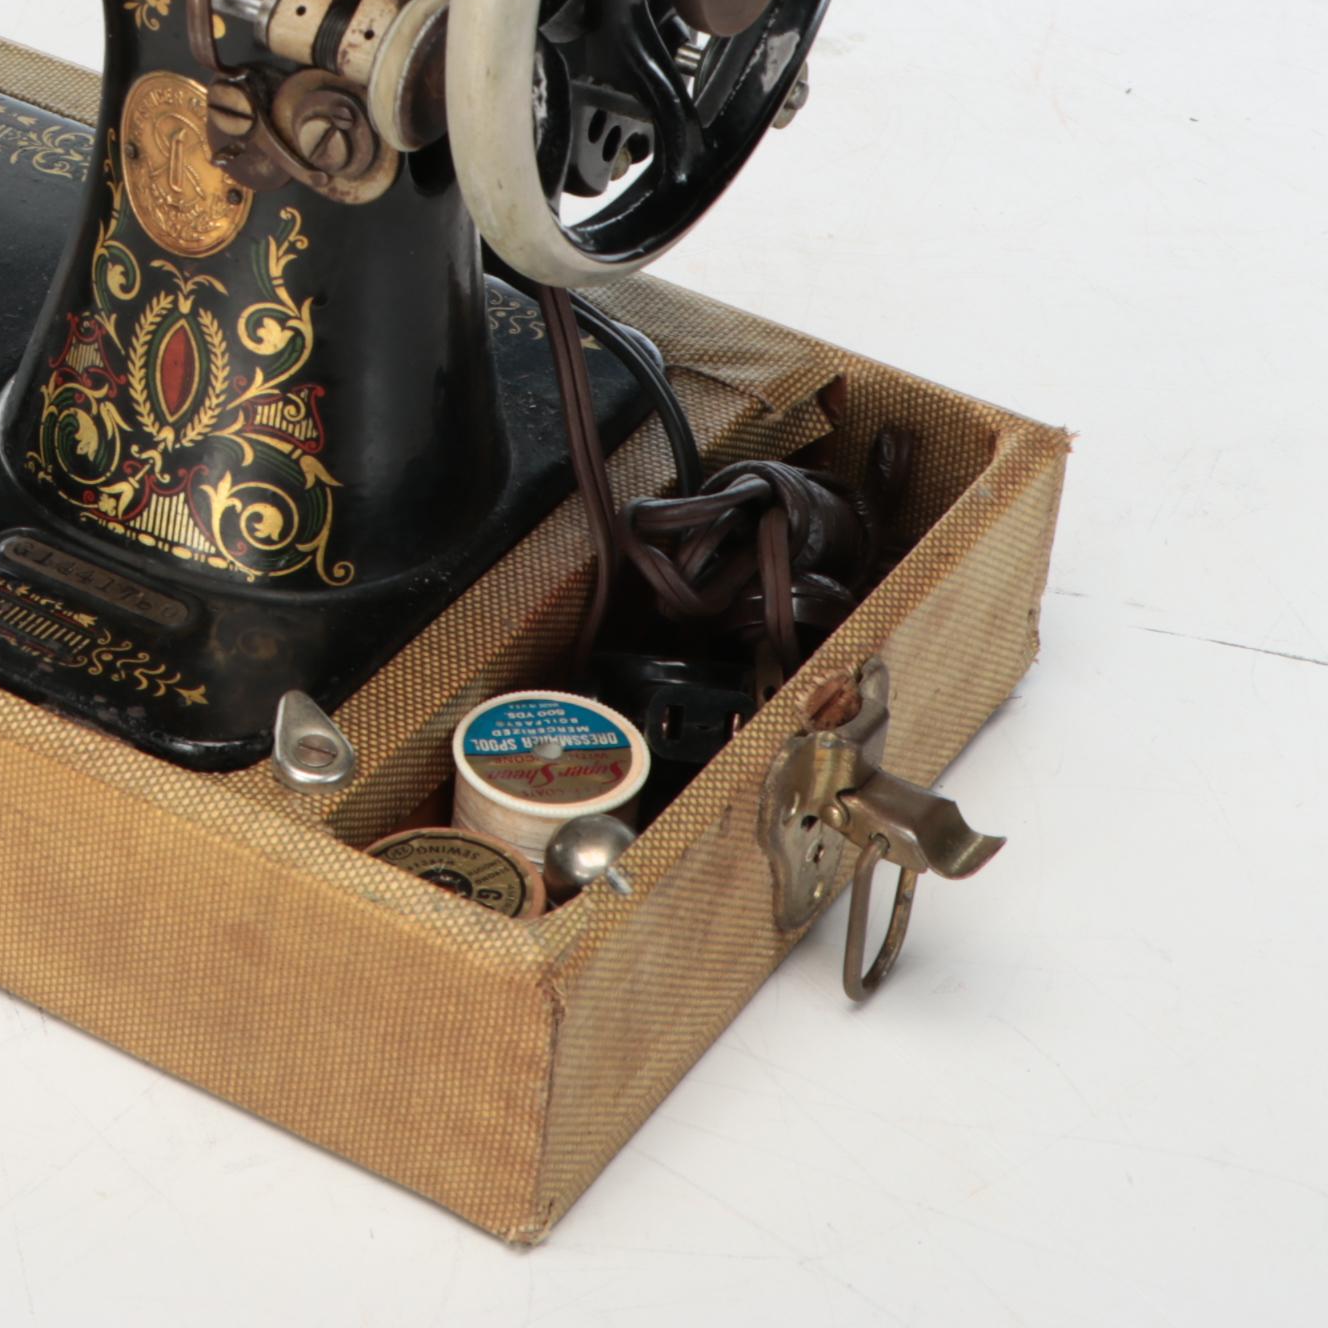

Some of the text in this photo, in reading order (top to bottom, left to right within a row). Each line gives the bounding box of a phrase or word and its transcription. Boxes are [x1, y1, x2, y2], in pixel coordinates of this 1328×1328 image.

[491, 725, 590, 737] MERCERIZED
[470, 738, 518, 752] SPOOL
[415, 844, 481, 860] SEWING
